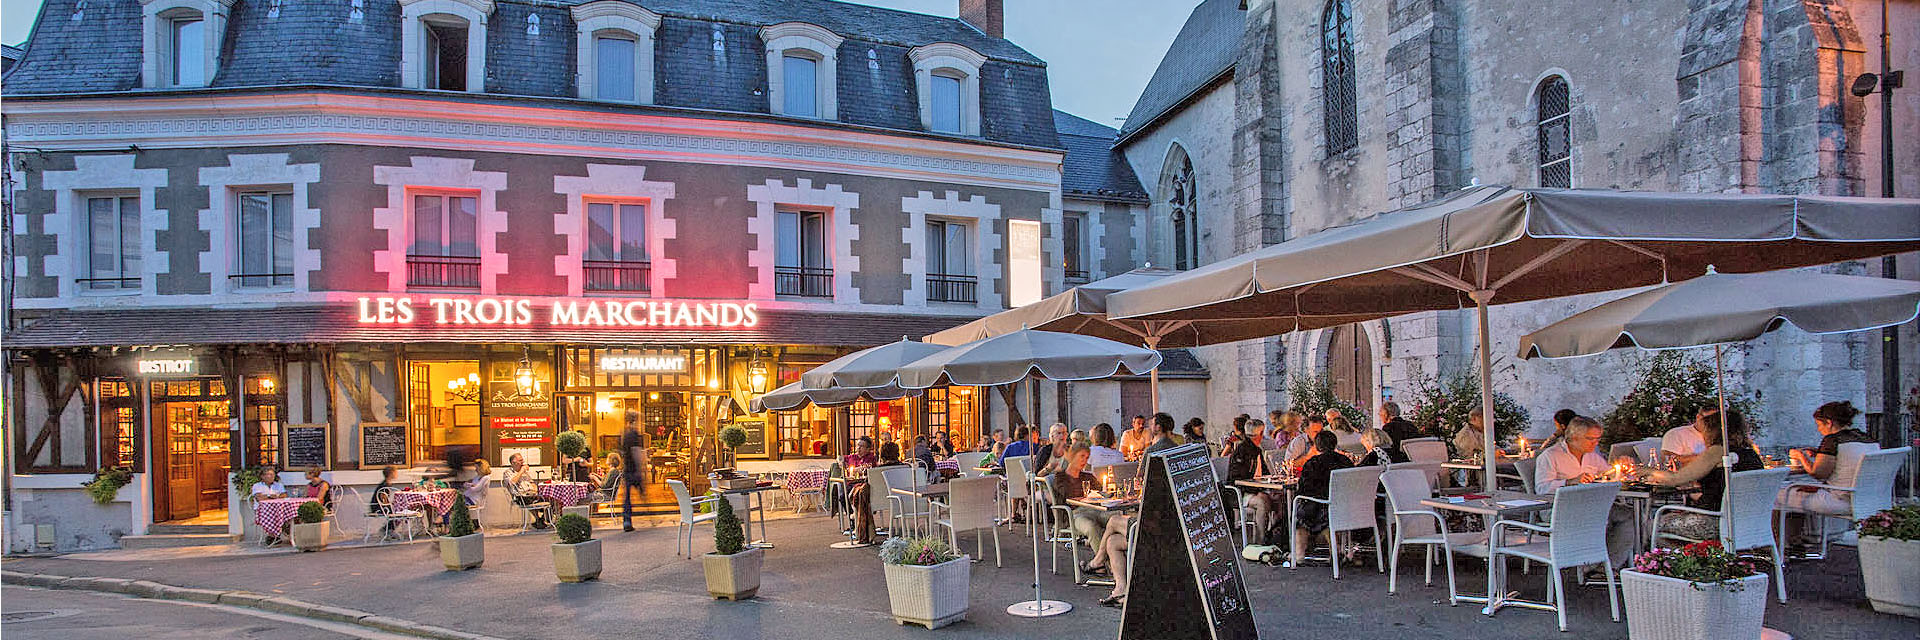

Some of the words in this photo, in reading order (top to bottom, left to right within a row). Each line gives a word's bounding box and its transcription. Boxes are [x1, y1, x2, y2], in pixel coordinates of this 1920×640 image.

[357, 297, 414, 323] LES
[429, 298, 532, 325] TROIS
[550, 300, 758, 327] MARCHANDS
[139, 360, 192, 373] BISTROT
[601, 357, 684, 370] RESTAURANT
